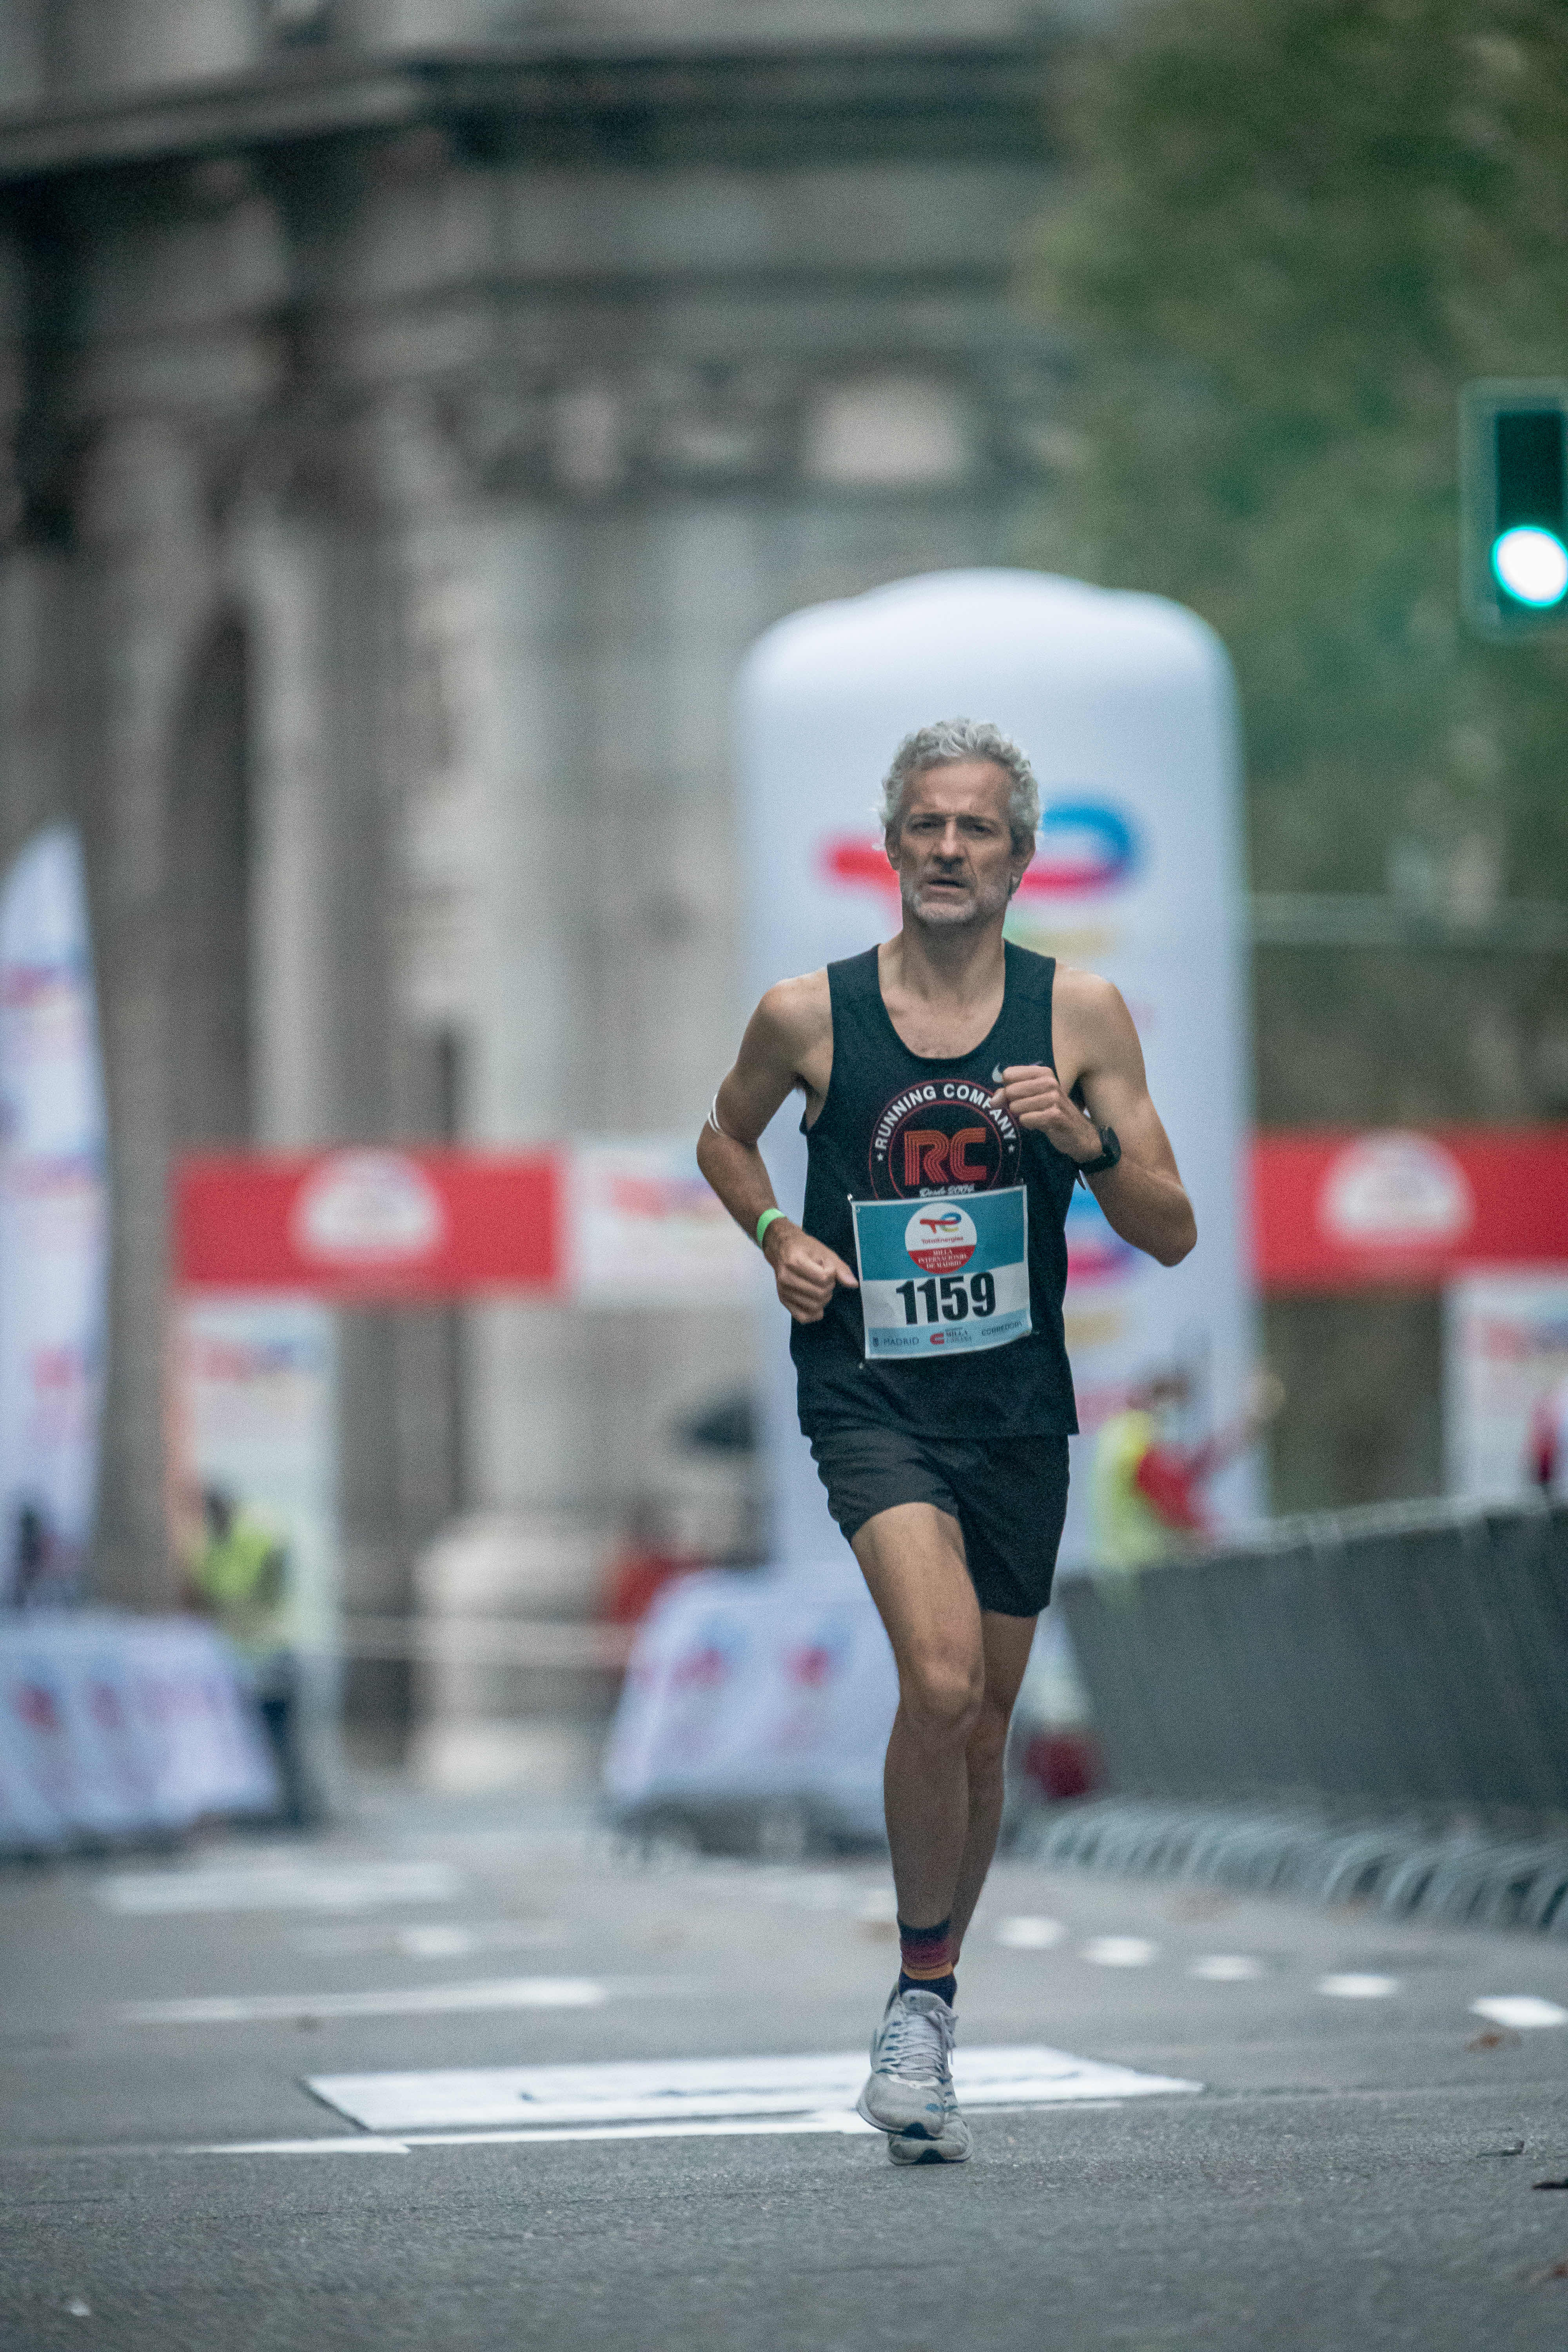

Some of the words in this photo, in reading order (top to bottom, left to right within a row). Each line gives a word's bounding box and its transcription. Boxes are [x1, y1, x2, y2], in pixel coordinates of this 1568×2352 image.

[875, 1085, 936, 1150] RUNNING
[904, 1127, 986, 1185] RC
[896, 1272, 996, 1325] 1159
[884, 1336, 920, 1346] MADRID
